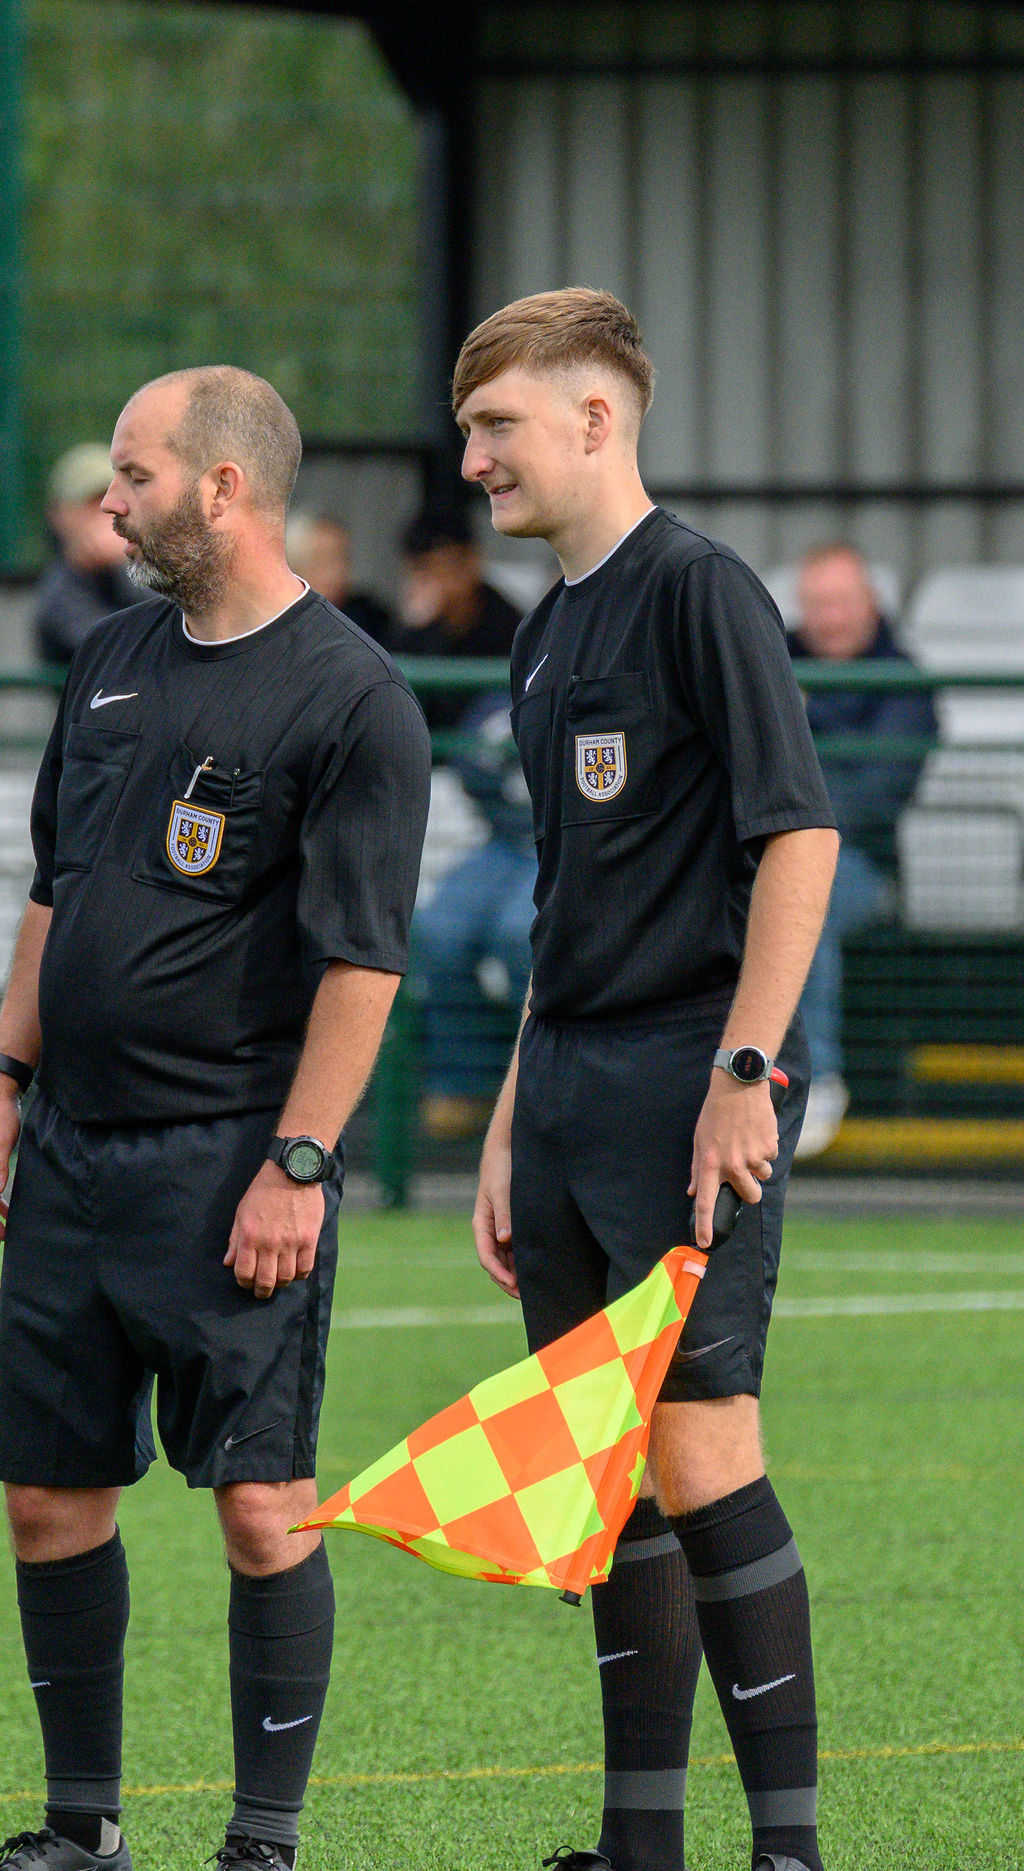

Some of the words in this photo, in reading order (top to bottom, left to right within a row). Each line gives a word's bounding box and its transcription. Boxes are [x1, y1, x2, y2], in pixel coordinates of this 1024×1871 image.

[579, 739, 600, 747] DURHAM
[600, 737, 622, 745] COUNTY
[176, 808, 198, 819] DURHAM
[197, 815, 220, 826] COUNTY
